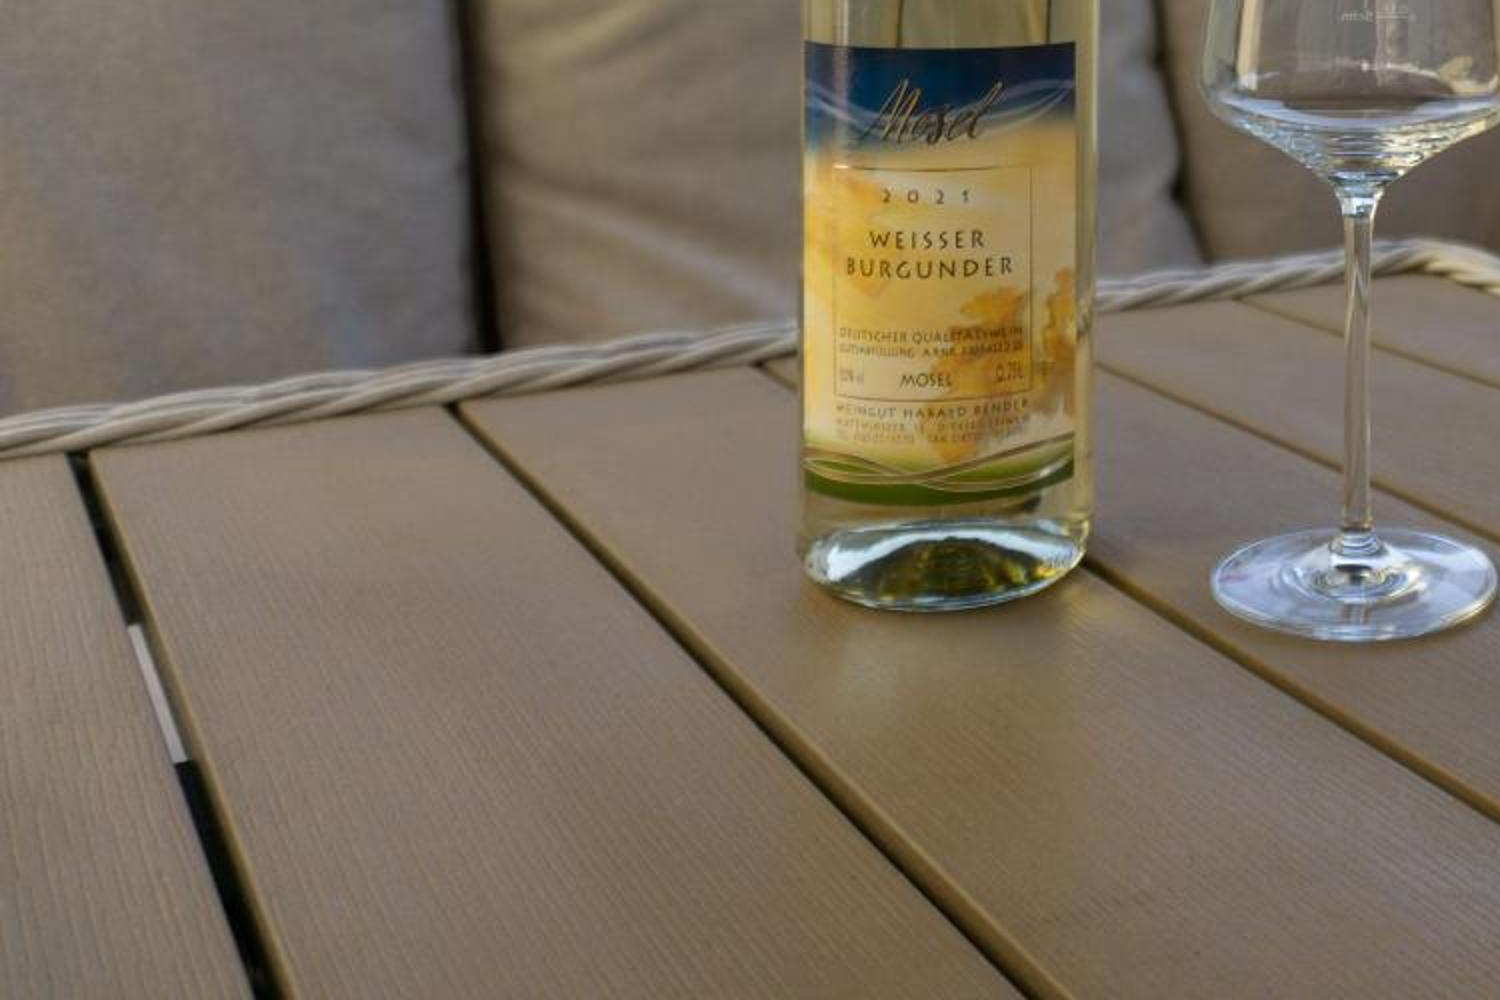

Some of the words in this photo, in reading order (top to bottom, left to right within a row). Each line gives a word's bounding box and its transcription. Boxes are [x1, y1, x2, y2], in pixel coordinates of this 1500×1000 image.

[882, 188, 972, 205] 2021
[869, 230, 985, 250] WEISSER
[847, 256, 1013, 280] BURGUNDER
[900, 372, 953, 388] MOSEL
